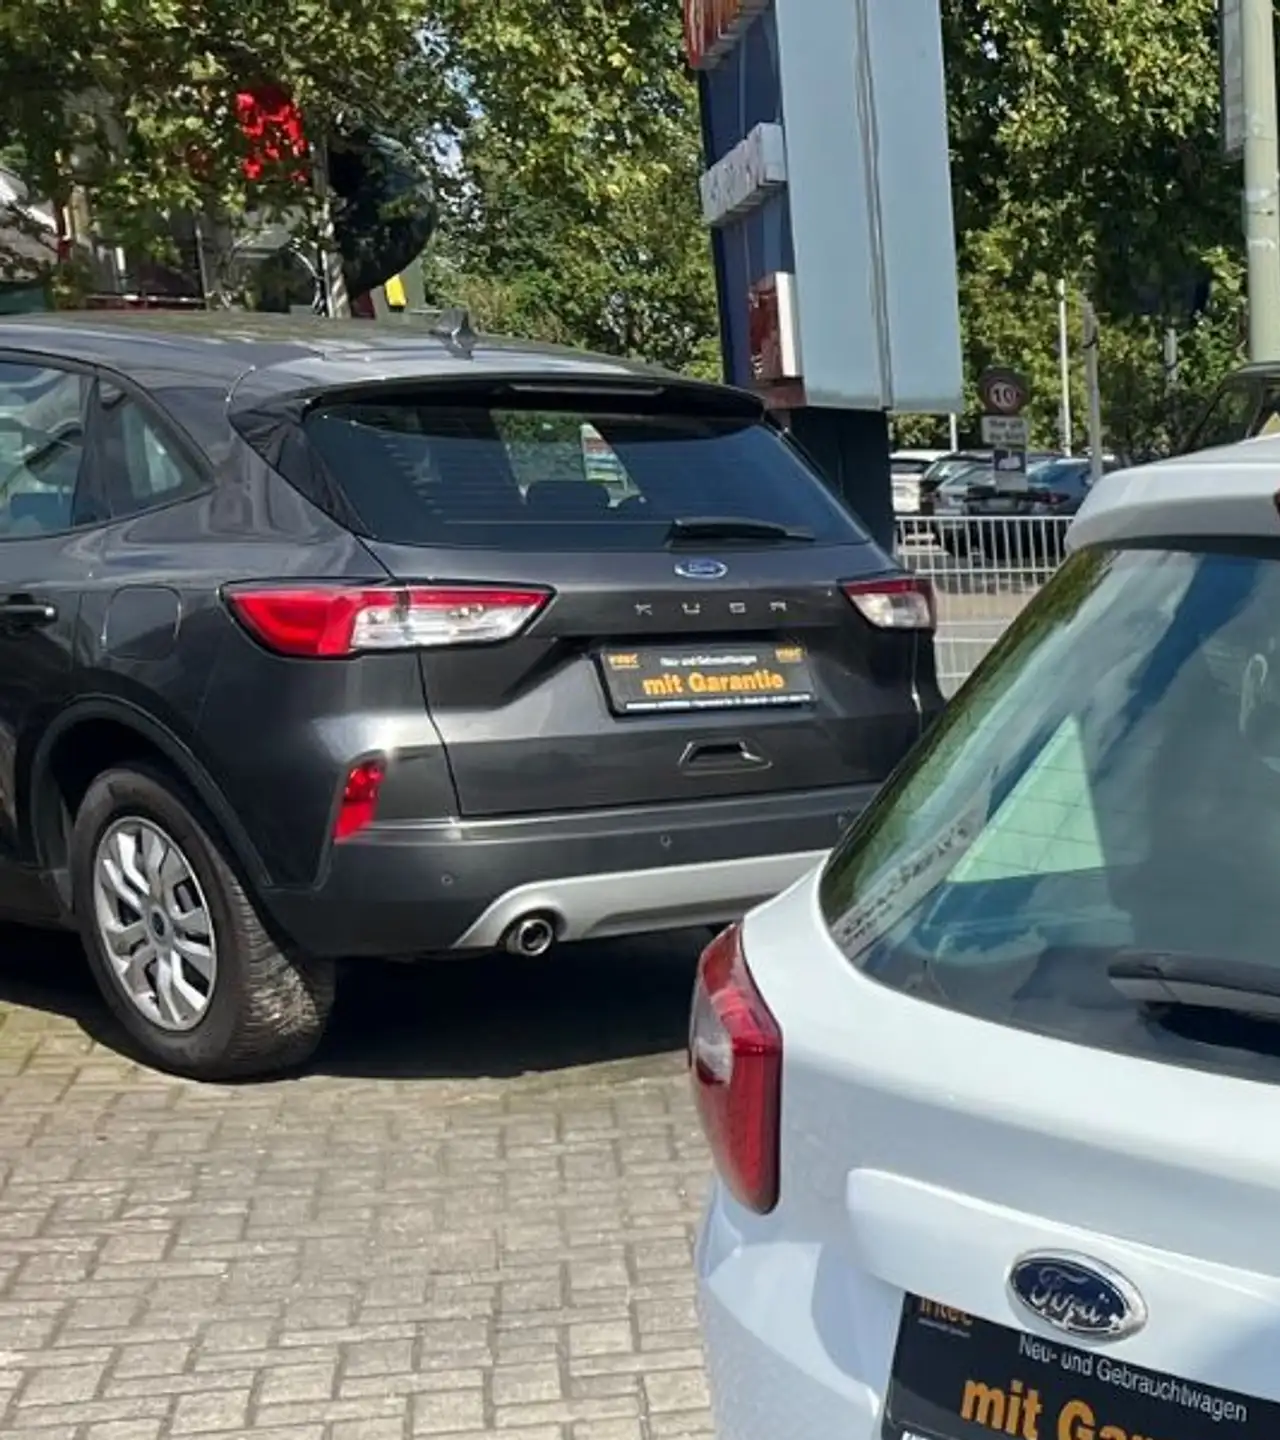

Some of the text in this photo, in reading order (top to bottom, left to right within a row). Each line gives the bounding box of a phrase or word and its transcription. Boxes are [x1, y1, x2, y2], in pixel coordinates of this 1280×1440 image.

[643, 669, 785, 696] mit Garantie
[1019, 1333, 1248, 1423] Neu- und Gebrauchtwagen
